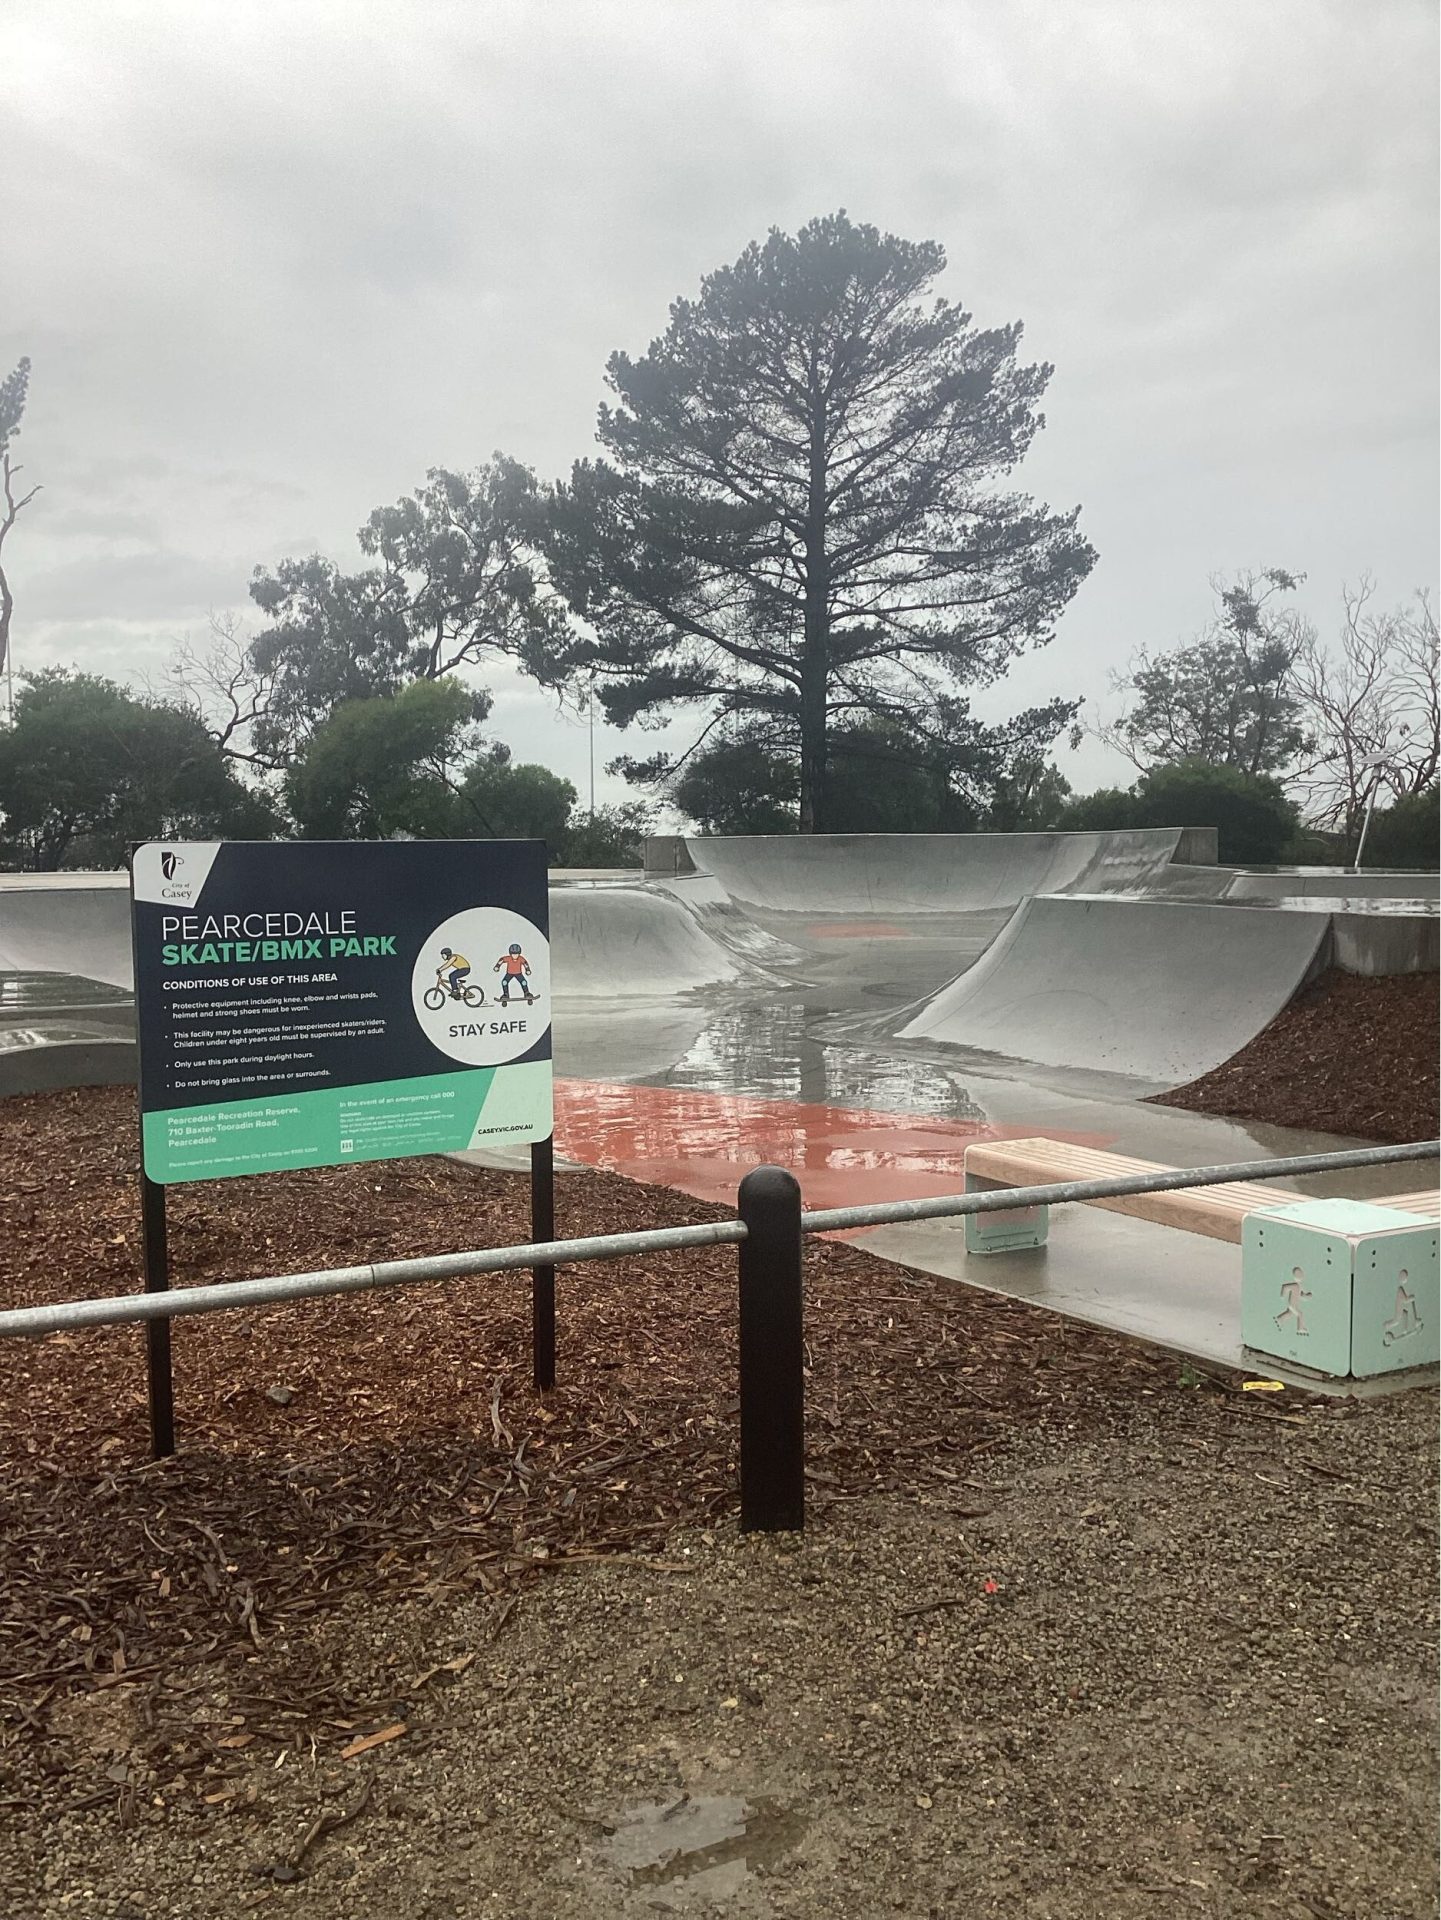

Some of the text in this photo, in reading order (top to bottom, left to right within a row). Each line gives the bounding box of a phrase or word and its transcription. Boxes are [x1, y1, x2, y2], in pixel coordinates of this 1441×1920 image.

[162, 888, 192, 900] Casey
[162, 910, 356, 940] PEARCEDALE
[162, 935, 397, 966] SKATE/BMX PARK
[162, 973, 338, 990] CONDITIONS OF USE OF THIS AREA
[172, 1002, 209, 1010] Protective
[210, 1000, 248, 1008] equipment
[190, 1030, 214, 1038] facility
[243, 1026, 280, 1034] dangerous
[293, 1021, 340, 1031] inexperienced
[449, 1020, 527, 1038] STAY SAFE
[174, 1040, 204, 1048] Children
[228, 1038, 247, 1046] eight
[248, 1036, 268, 1044] years
[310, 1030, 346, 1039] supervised
[174, 1060, 192, 1068] Only
[222, 1057, 238, 1065] park
[240, 1055, 263, 1063] during
[264, 1053, 292, 1061] daylight
[201, 1078, 220, 1086] bring
[222, 1077, 240, 1085] glass
[295, 1069, 331, 1078] surrounds.
[168, 1114, 216, 1125] Pearcedale
[218, 1110, 263, 1120] Recreation
[168, 1128, 183, 1136] 710
[478, 1124, 534, 1135] CASEY.VIC.GOV.AU
[168, 1136, 216, 1148] Pearcedale
